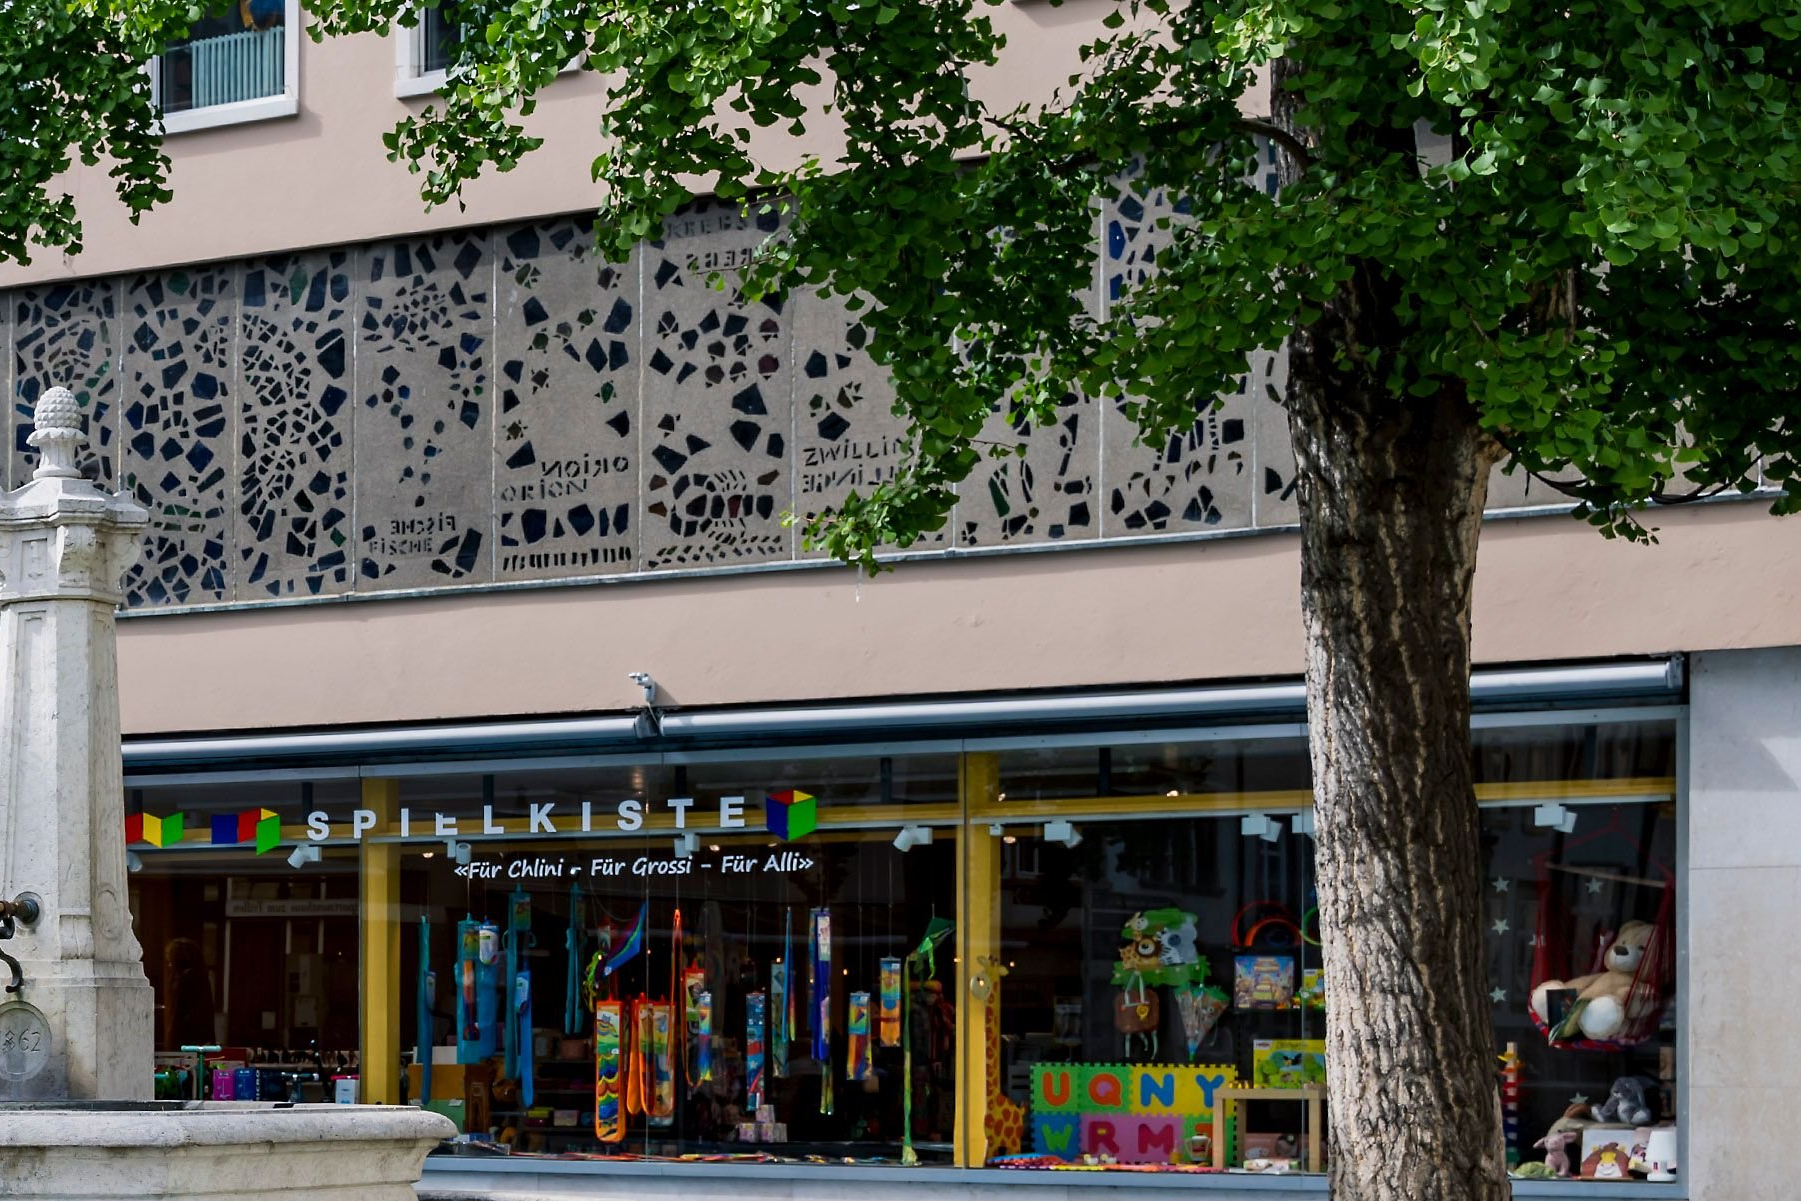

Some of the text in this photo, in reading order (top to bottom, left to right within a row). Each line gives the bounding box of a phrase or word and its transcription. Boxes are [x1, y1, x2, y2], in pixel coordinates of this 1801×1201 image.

[306, 796, 745, 842] SPIELKISTE
[507, 857, 563, 879] Chlini
[590, 857, 626, 876] Für
[631, 855, 694, 876] Grossi
[721, 854, 758, 874] Für
